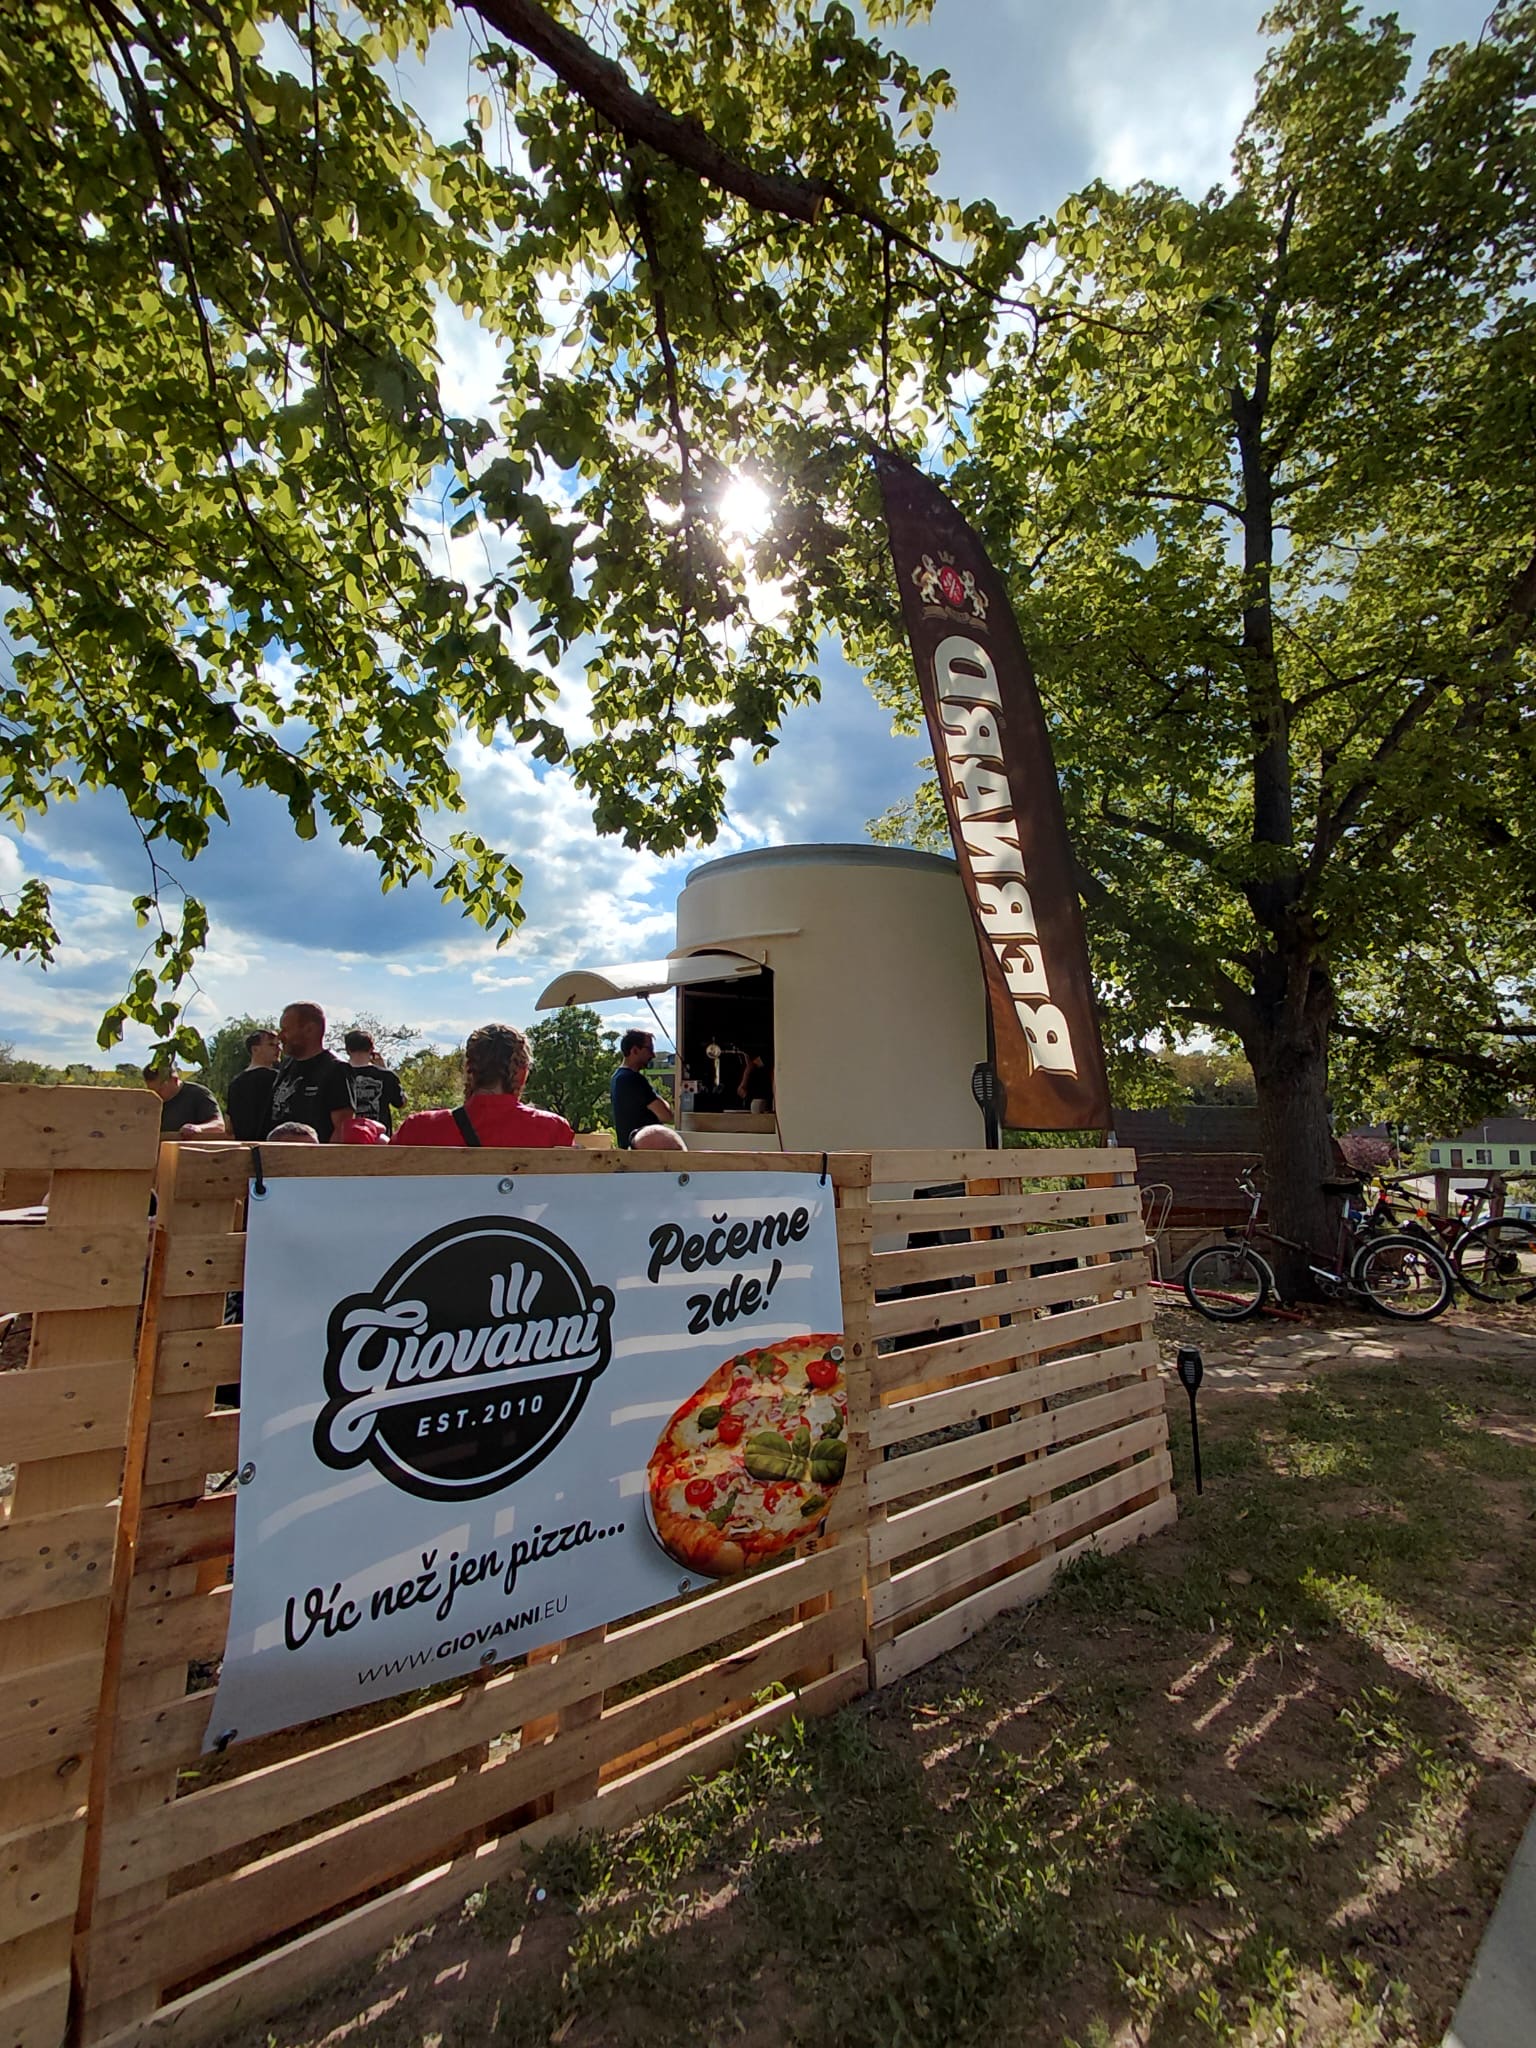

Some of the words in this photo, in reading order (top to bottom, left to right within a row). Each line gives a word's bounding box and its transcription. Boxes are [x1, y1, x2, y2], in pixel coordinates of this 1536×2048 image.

[648, 1206, 810, 1284] Pečeme
[686, 1258, 782, 1335] zde!
[329, 1299, 605, 1453] Giovanni
[284, 1582, 362, 1651] Víc
[370, 1548, 443, 1620] než
[436, 1550, 503, 1622] jen
[502, 1519, 626, 1596] pizza...
[357, 1594, 569, 1685] WWW.GIOVANNI.EU
